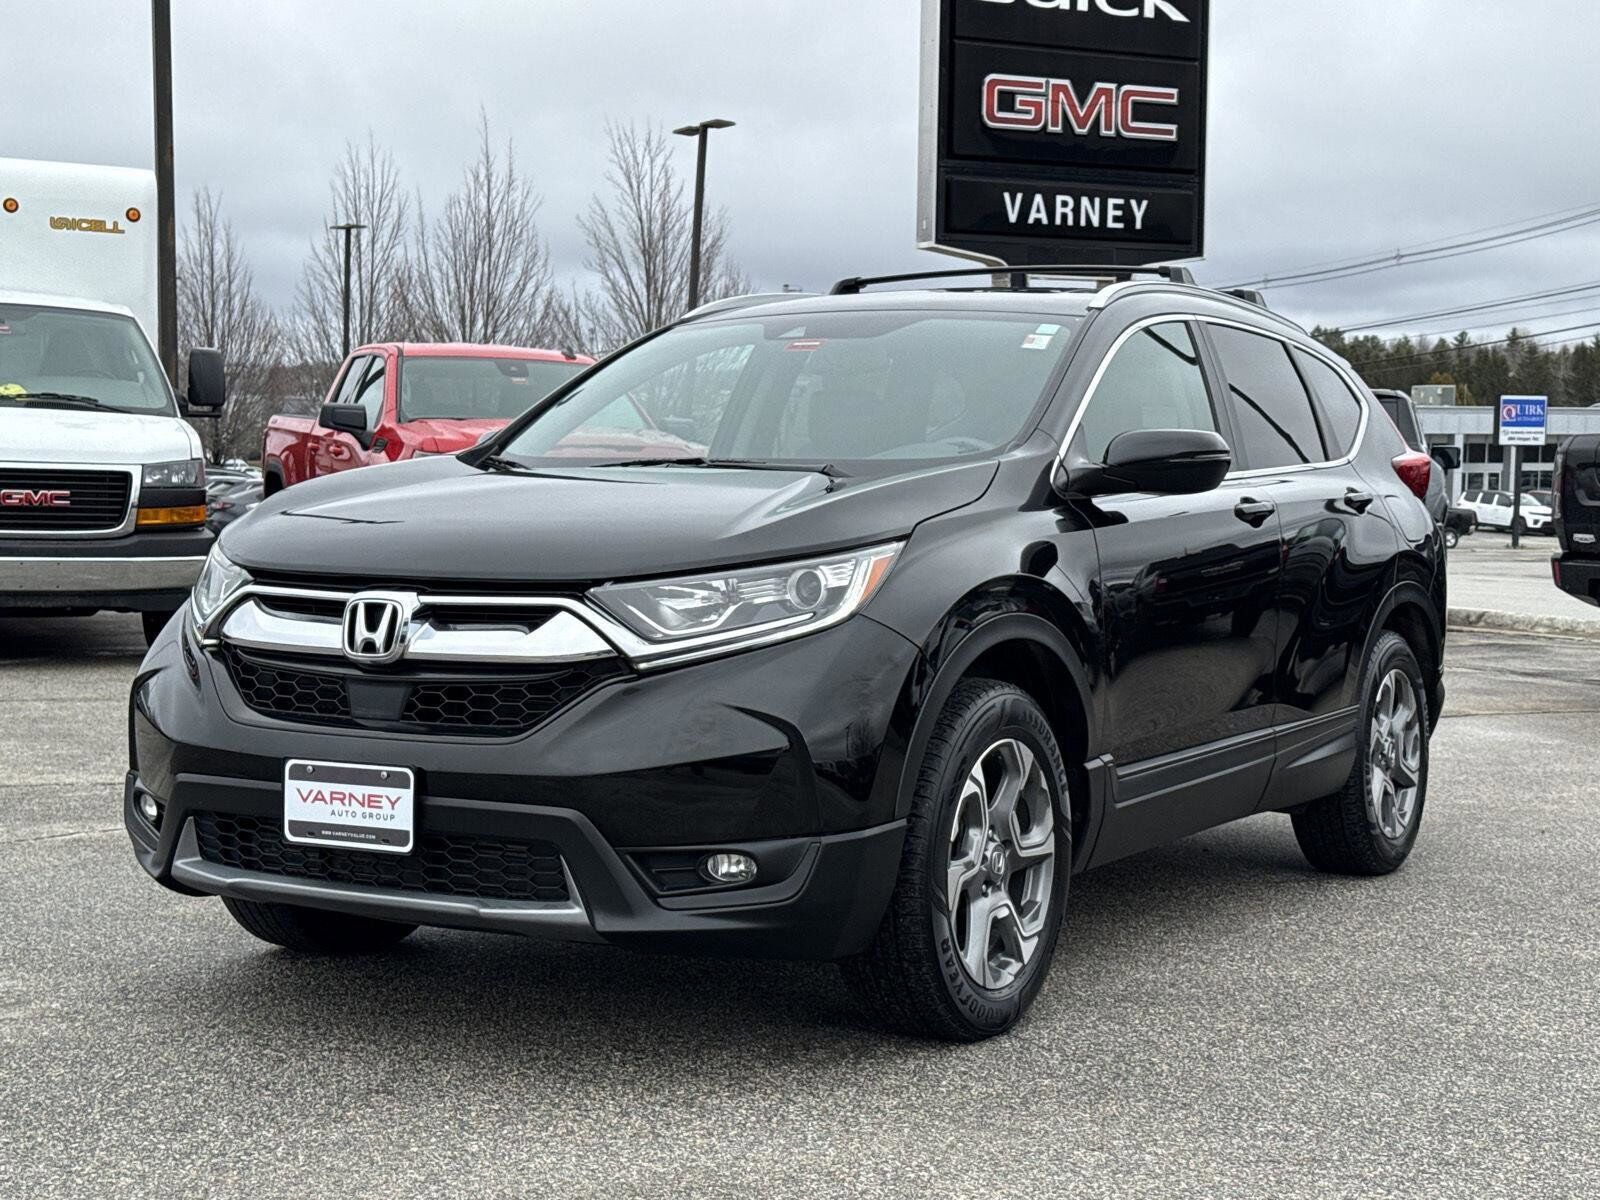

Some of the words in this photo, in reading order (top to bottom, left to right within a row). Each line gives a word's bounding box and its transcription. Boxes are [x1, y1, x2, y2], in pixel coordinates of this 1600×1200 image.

[981, 73, 1179, 141] GMC
[1003, 191, 1149, 230] VARNEY
[1503, 404, 1543, 421] QUIRK
[0, 489, 71, 506] GMC
[296, 787, 402, 811] VARNEY
[330, 809, 357, 818] AUTO
[361, 811, 396, 822] GROUP
[940, 937, 1003, 1023] OODYEAR
